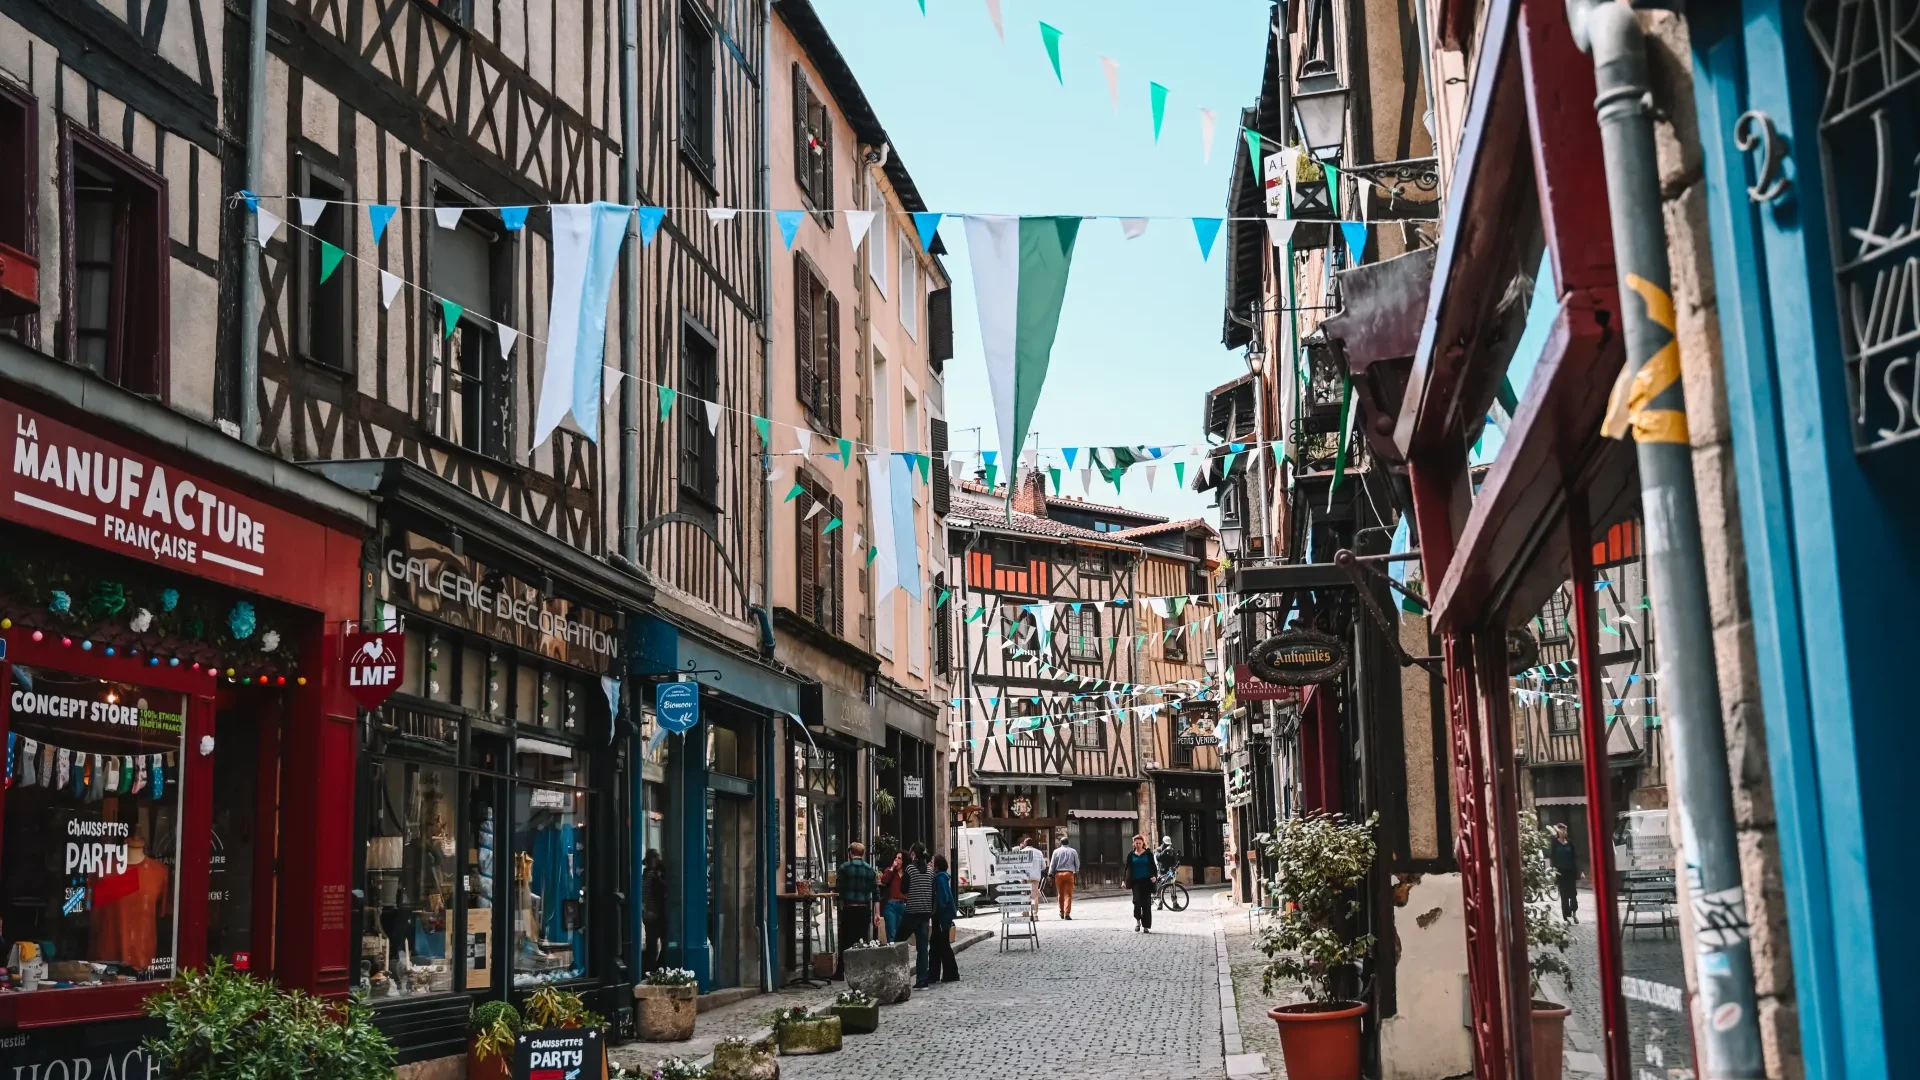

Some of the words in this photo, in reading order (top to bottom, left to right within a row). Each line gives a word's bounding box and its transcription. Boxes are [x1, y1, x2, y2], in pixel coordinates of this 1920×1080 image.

[17, 414, 38, 440] LA
[14, 437, 265, 554] MANUFACTURE
[104, 514, 197, 563] FRANÇAISE
[367, 573, 373, 588] 9
[387, 549, 492, 614] GALERIE
[496, 592, 618, 658] DECORATION
[1273, 649, 1331, 666] Antiquités
[350, 666, 396, 686] LMF
[11, 690, 88, 719] CONCEPT
[91, 701, 138, 726] STORE
